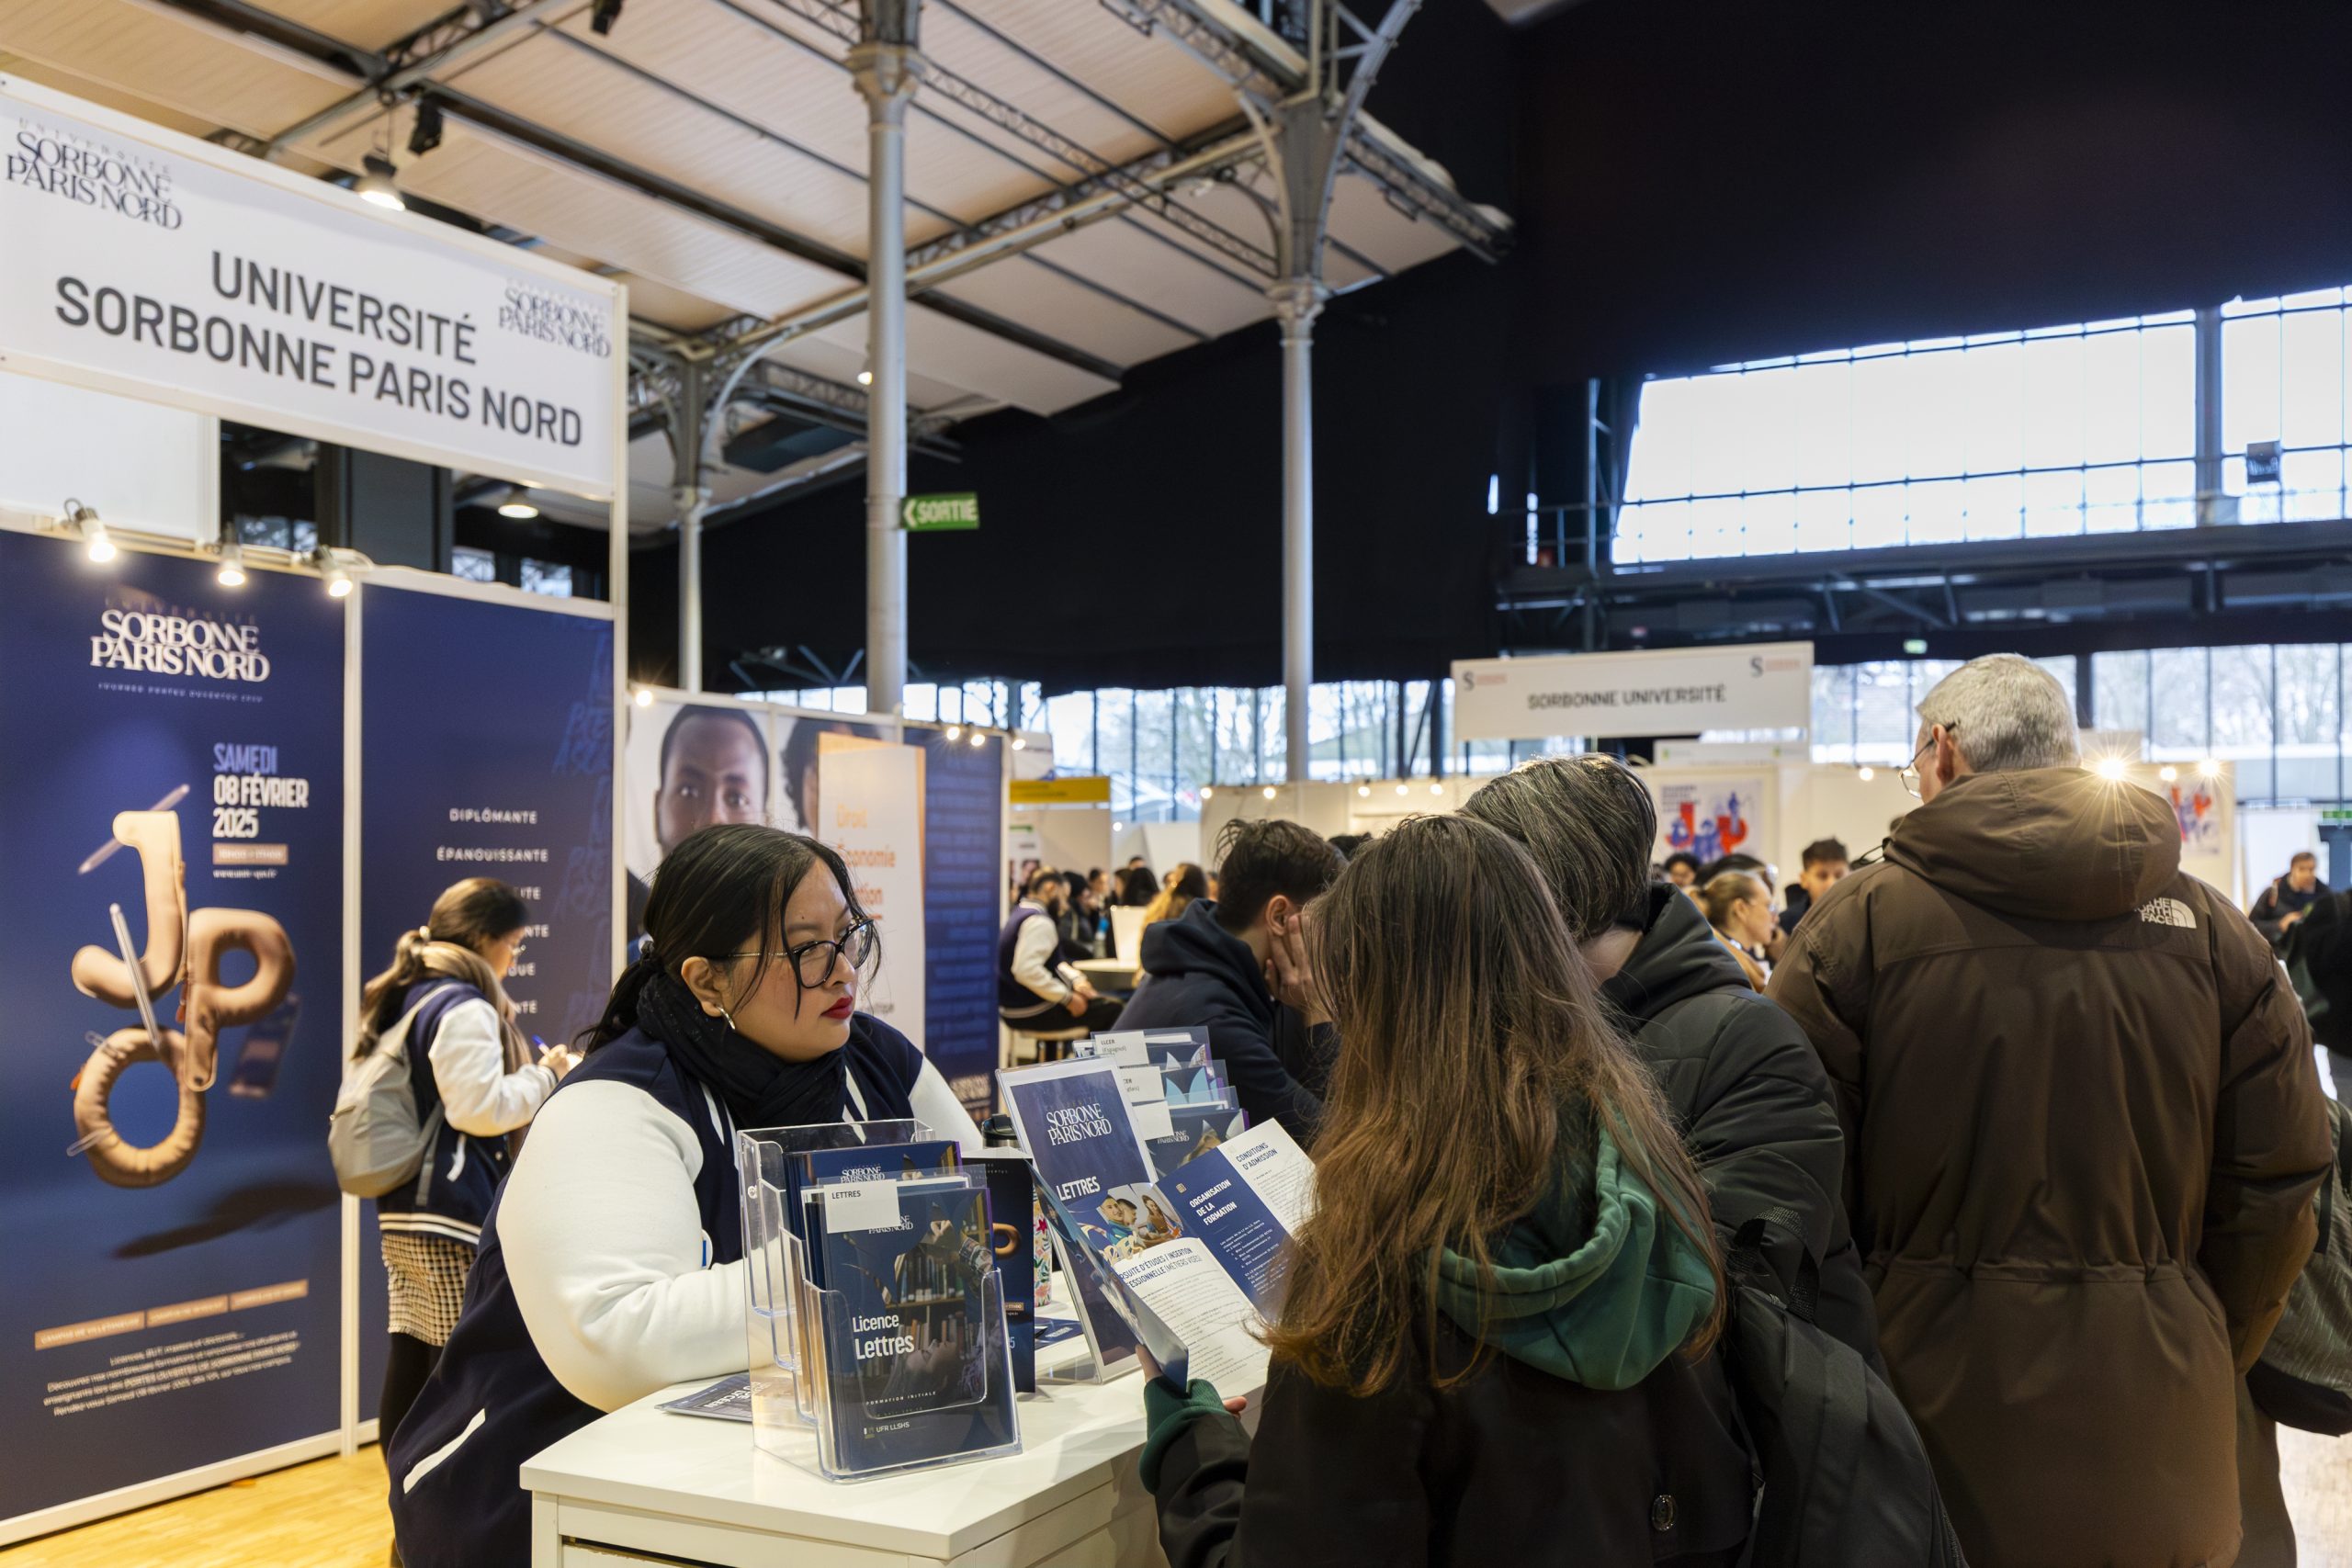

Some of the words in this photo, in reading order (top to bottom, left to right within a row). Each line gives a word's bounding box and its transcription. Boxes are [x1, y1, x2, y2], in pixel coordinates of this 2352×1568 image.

[17, 131, 172, 203] SORBONNE
[6, 153, 96, 205] PARIS
[101, 184, 182, 230] NORD
[211, 250, 477, 365] UNIVERSITÉ
[504, 288, 605, 333] SORBONNE
[499, 306, 555, 343] PARIS
[558, 326, 612, 359] NORD
[55, 276, 336, 389] SORBONNE
[349, 351, 470, 420] PARIS
[481, 387, 582, 447] NORD
[917, 500, 978, 524] SORTIE
[101, 609, 260, 654] SORBONNE
[90, 636, 184, 674] PARIS
[185, 646, 271, 682] NORD
[1527, 691, 1620, 710] SORBONNE
[1622, 682, 1727, 706] UNIVERSITÉ
[213, 742, 278, 774] SAMEDI
[213, 774, 240, 806] 08
[241, 771, 310, 808] FÉVRIER
[212, 807, 259, 838] 2025
[449, 807, 537, 824] DIPLÔMANTE
[436, 845, 548, 862] ÉPANOUISSANTE
[2141, 912, 2174, 925] FACE
[1046, 1103, 1104, 1129] SORBONNE
[1048, 1124, 1082, 1145] PARIS
[1080, 1119, 1112, 1139] NORD
[1236, 1143, 1269, 1163] CONDITIONS
[1242, 1148, 1278, 1170] D'ADMISSION
[842, 1167, 882, 1177] SORBONNE
[831, 1190, 861, 1200] LETTRES
[1057, 1176, 1101, 1201] LETTRES
[1189, 1179, 1231, 1208] ORGANISATION
[1196, 1206, 1207, 1216] DE
[1204, 1202, 1215, 1212] LA
[1204, 1201, 1237, 1225] FORMATION
[1119, 1268, 1141, 1280] RSUITE
[1169, 1247, 1193, 1260] INSERTION
[852, 1314, 899, 1332] Licence
[854, 1335, 914, 1359] Lettres
[865, 1396, 904, 1406] FORMATION
[907, 1391, 937, 1399] INITIALE
[876, 1425, 888, 1433] UFR
[889, 1422, 910, 1431] LLSHS
